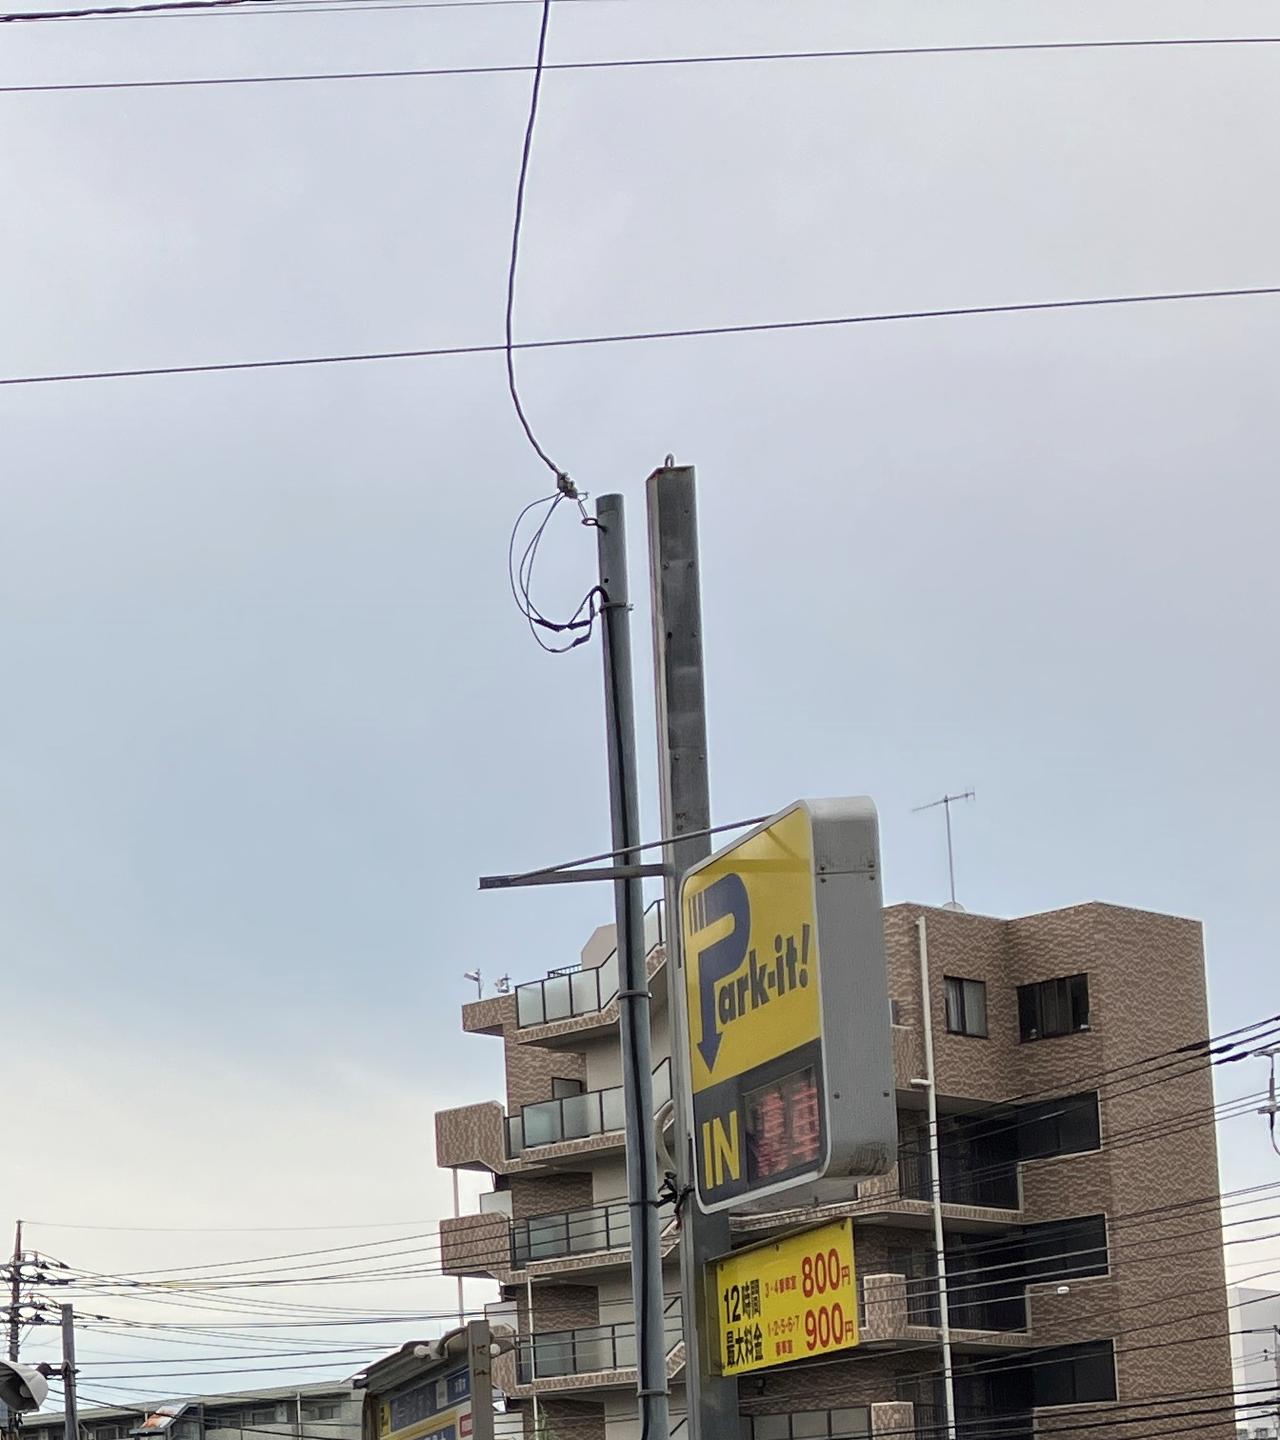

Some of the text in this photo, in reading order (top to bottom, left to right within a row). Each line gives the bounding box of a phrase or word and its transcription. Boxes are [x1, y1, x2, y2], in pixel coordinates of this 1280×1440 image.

[688, 873, 811, 1074] Park-it!
[702, 1110, 740, 1190] IN
[724, 1279, 761, 1324] 12時間
[802, 1248, 851, 1298] 800円
[727, 1322, 764, 1368] 最大料金
[805, 1302, 855, 1351] 900円
